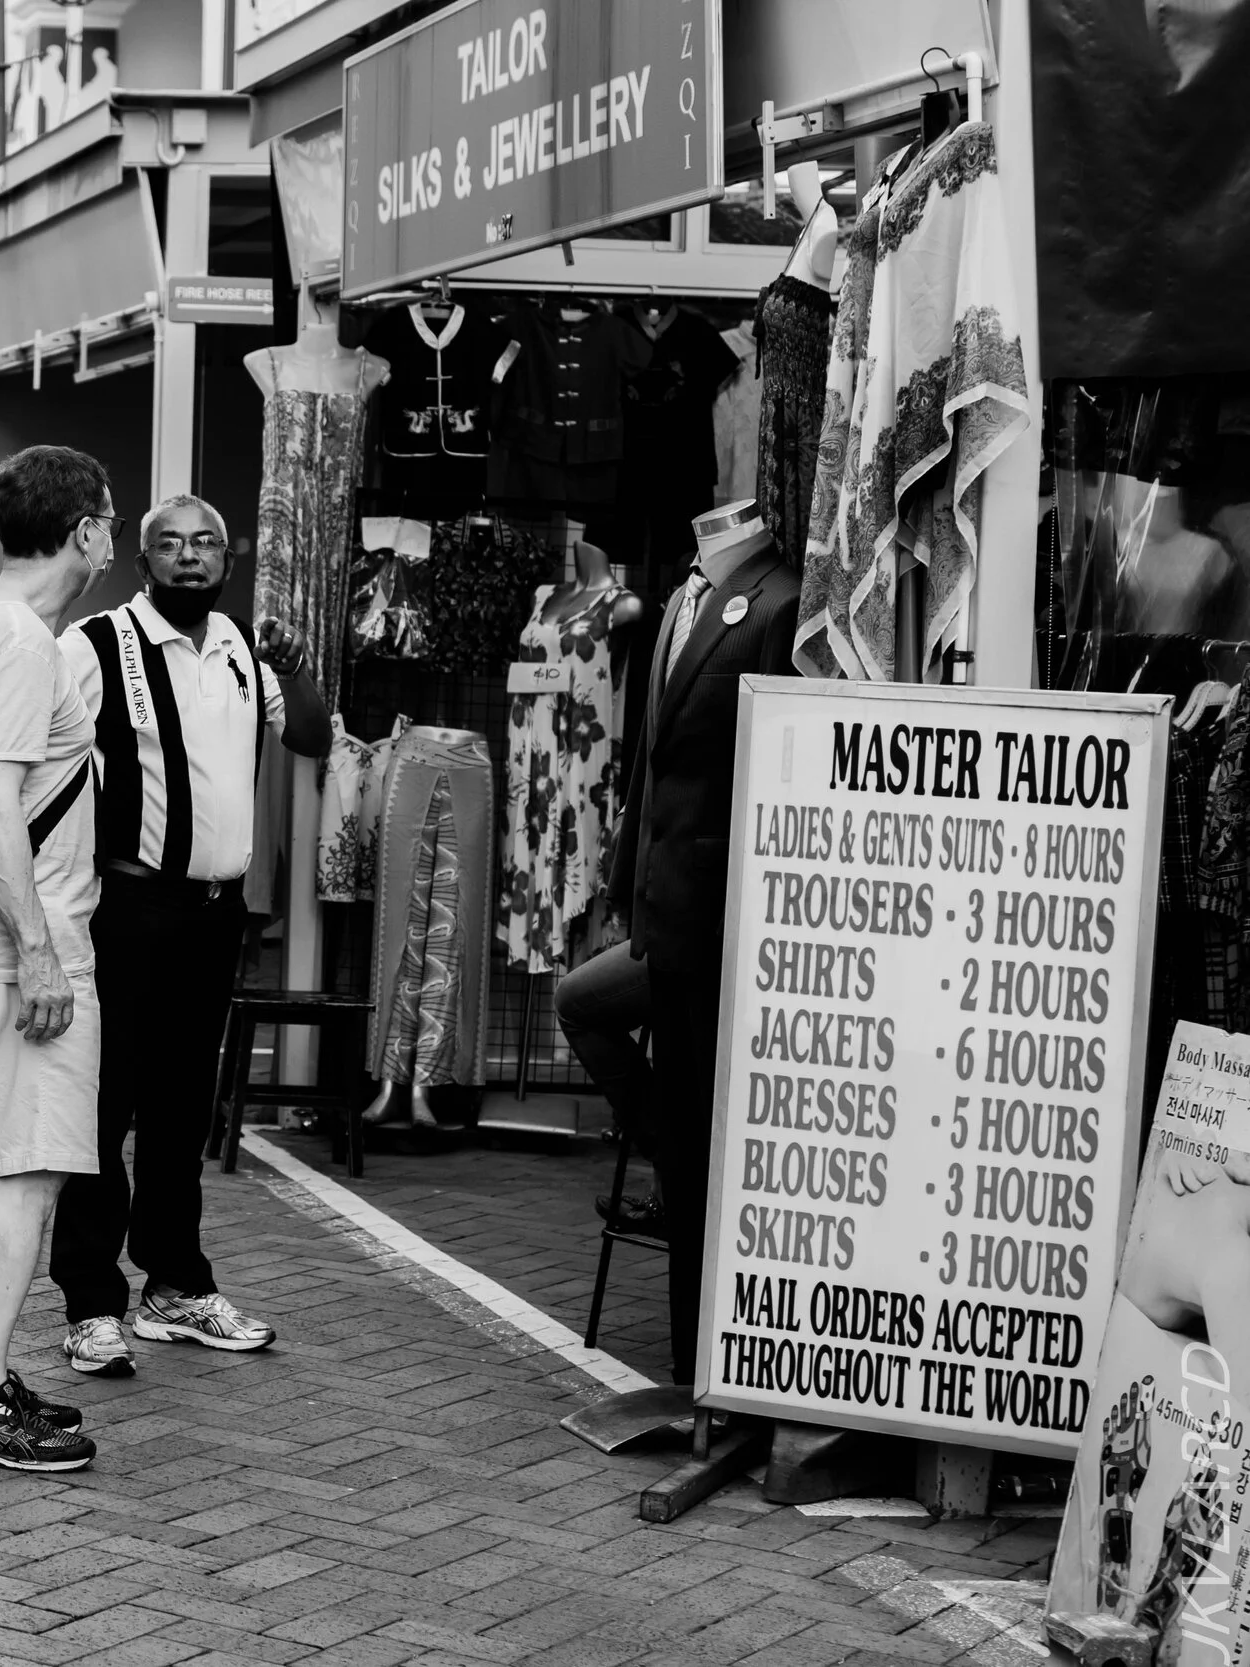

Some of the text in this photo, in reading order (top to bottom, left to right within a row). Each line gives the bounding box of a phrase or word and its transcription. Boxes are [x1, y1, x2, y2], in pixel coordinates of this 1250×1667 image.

[457, 9, 547, 104] TAILOR
[377, 64, 650, 224] SILKS & JEWELLERY
[175, 286, 205, 299] FIRE
[207, 287, 244, 300] HOSE
[121, 629, 149, 725] RALPH LAUREN
[534, 667, 560, 684] $10
[830, 722, 1130, 810] MASTER TAILOR
[755, 804, 1125, 884] LADIES & GENTS SUITS 8 HOURS
[763, 871, 1115, 954] TROUSERS 3 HOURS
[756, 938, 1109, 1024] SHIRTS 2 HOURS
[751, 1007, 1105, 1093] JACKETS 6 HOURS
[1177, 1043, 1208, 1072] Body
[747, 1072, 1099, 1163] DRESSES 5 HOURS
[1159, 1129, 1229, 1165] 30mins $30
[742, 1138, 1094, 1231] BLOUSES 3 HOURS
[737, 1204, 1088, 1300] SKIRTS 3 HOURS
[732, 1272, 1083, 1368] MAIL ORDERS ACCEPTED
[720, 1332, 1090, 1433] THROUGHOUT THE WORLD
[1208, 1410, 1243, 1449] $30
